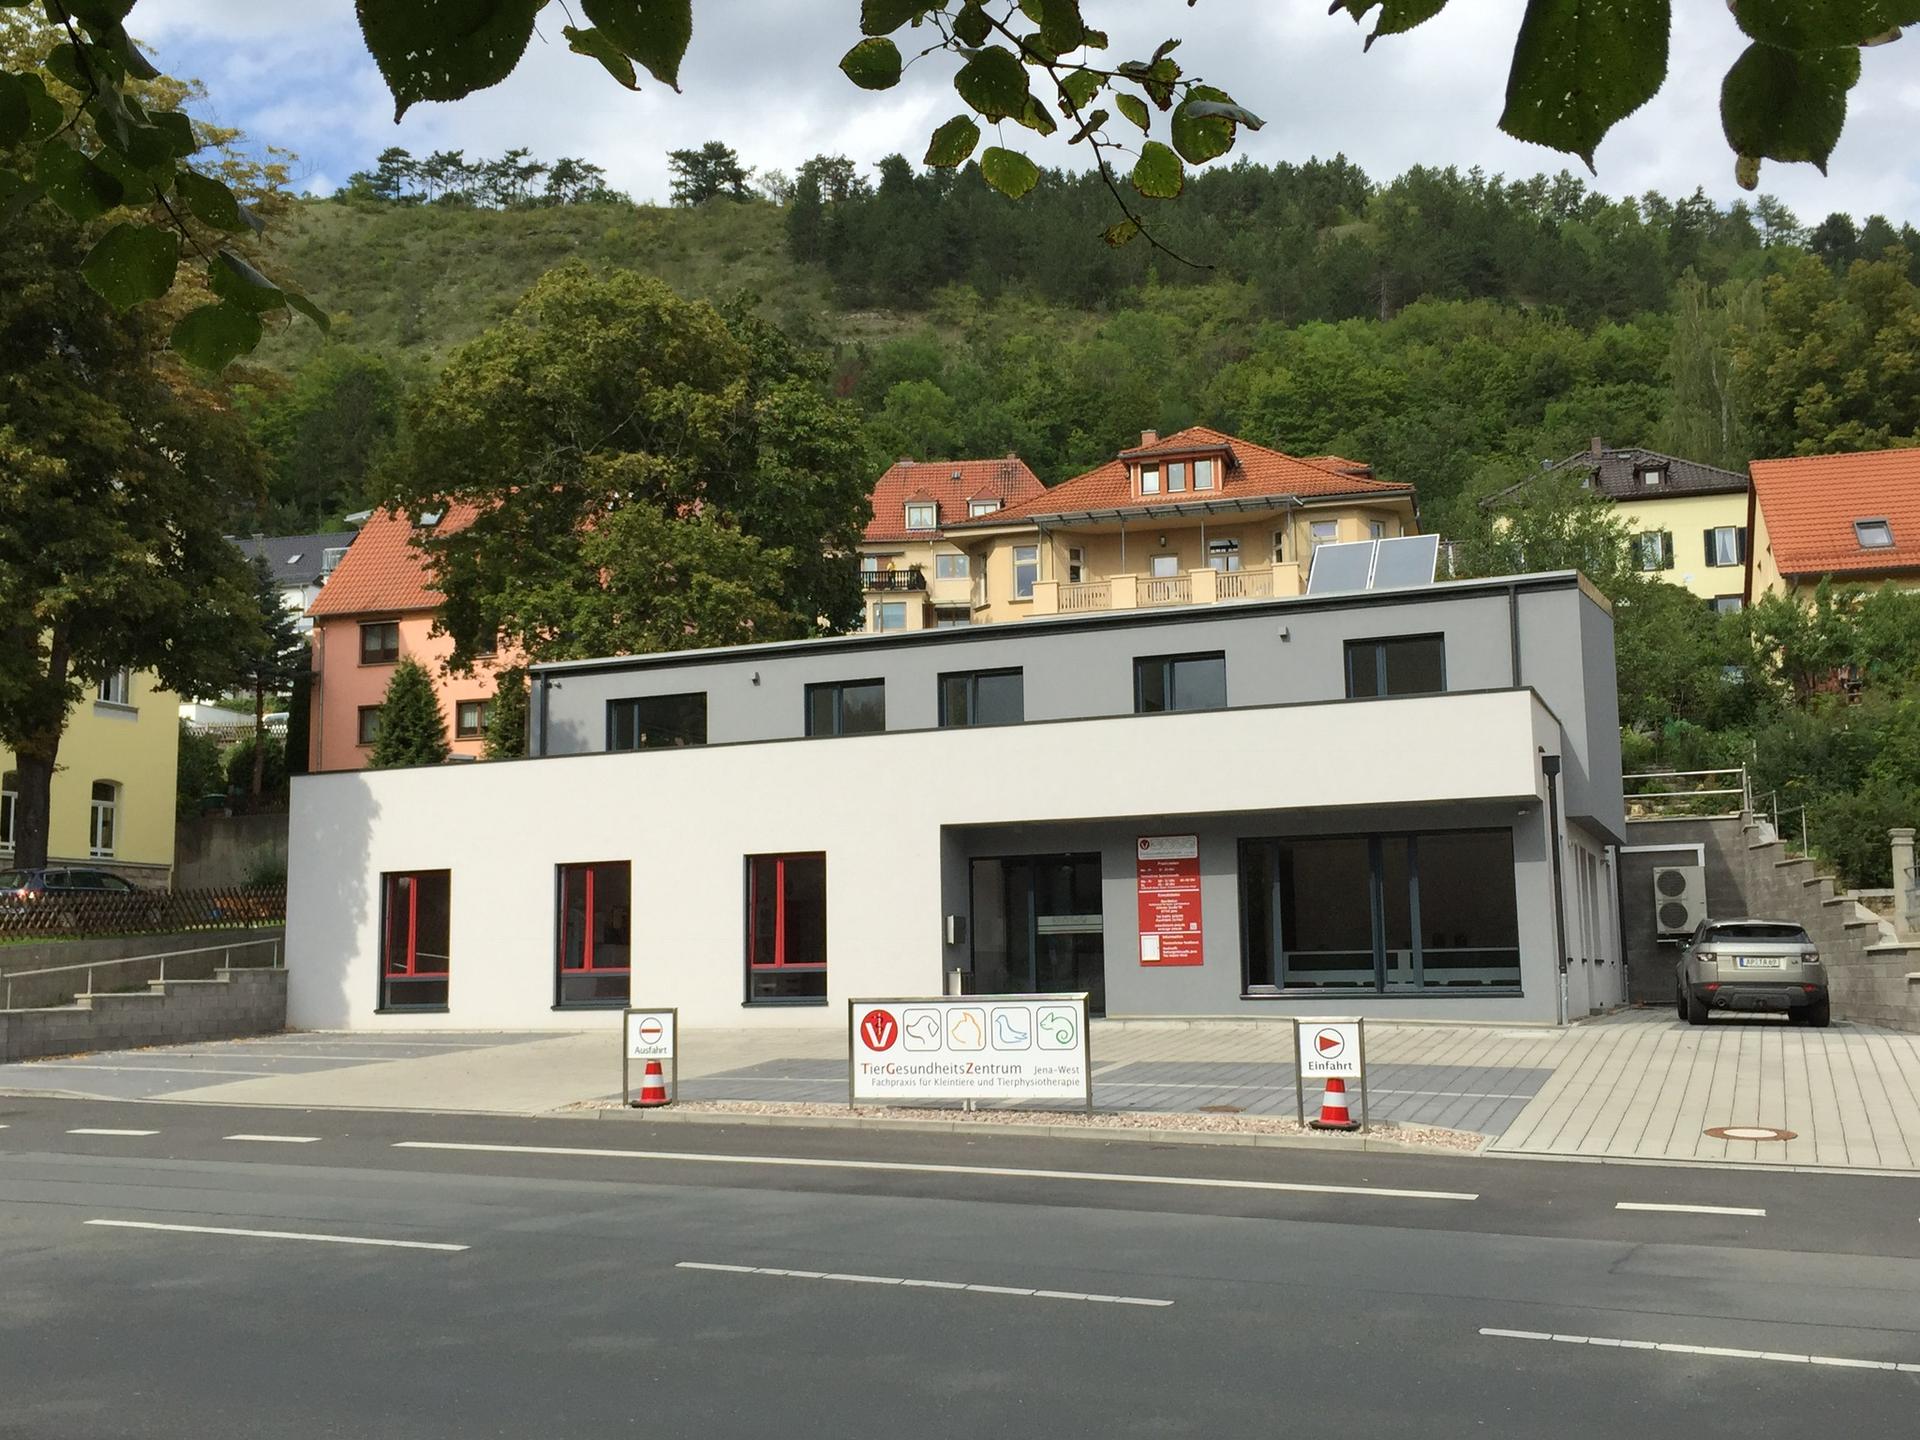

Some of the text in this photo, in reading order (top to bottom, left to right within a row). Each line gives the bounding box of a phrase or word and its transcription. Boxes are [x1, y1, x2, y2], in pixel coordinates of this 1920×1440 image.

[634, 1046, 668, 1055] Ausfahrt
[861, 1062, 1080, 1075] TierGesundheitsZentrum Jena-West
[1308, 1060, 1353, 1071] Einfahrt
[872, 1077, 1080, 1087] Fachpraxis für Kleintiere und Tierphysiotherapie
